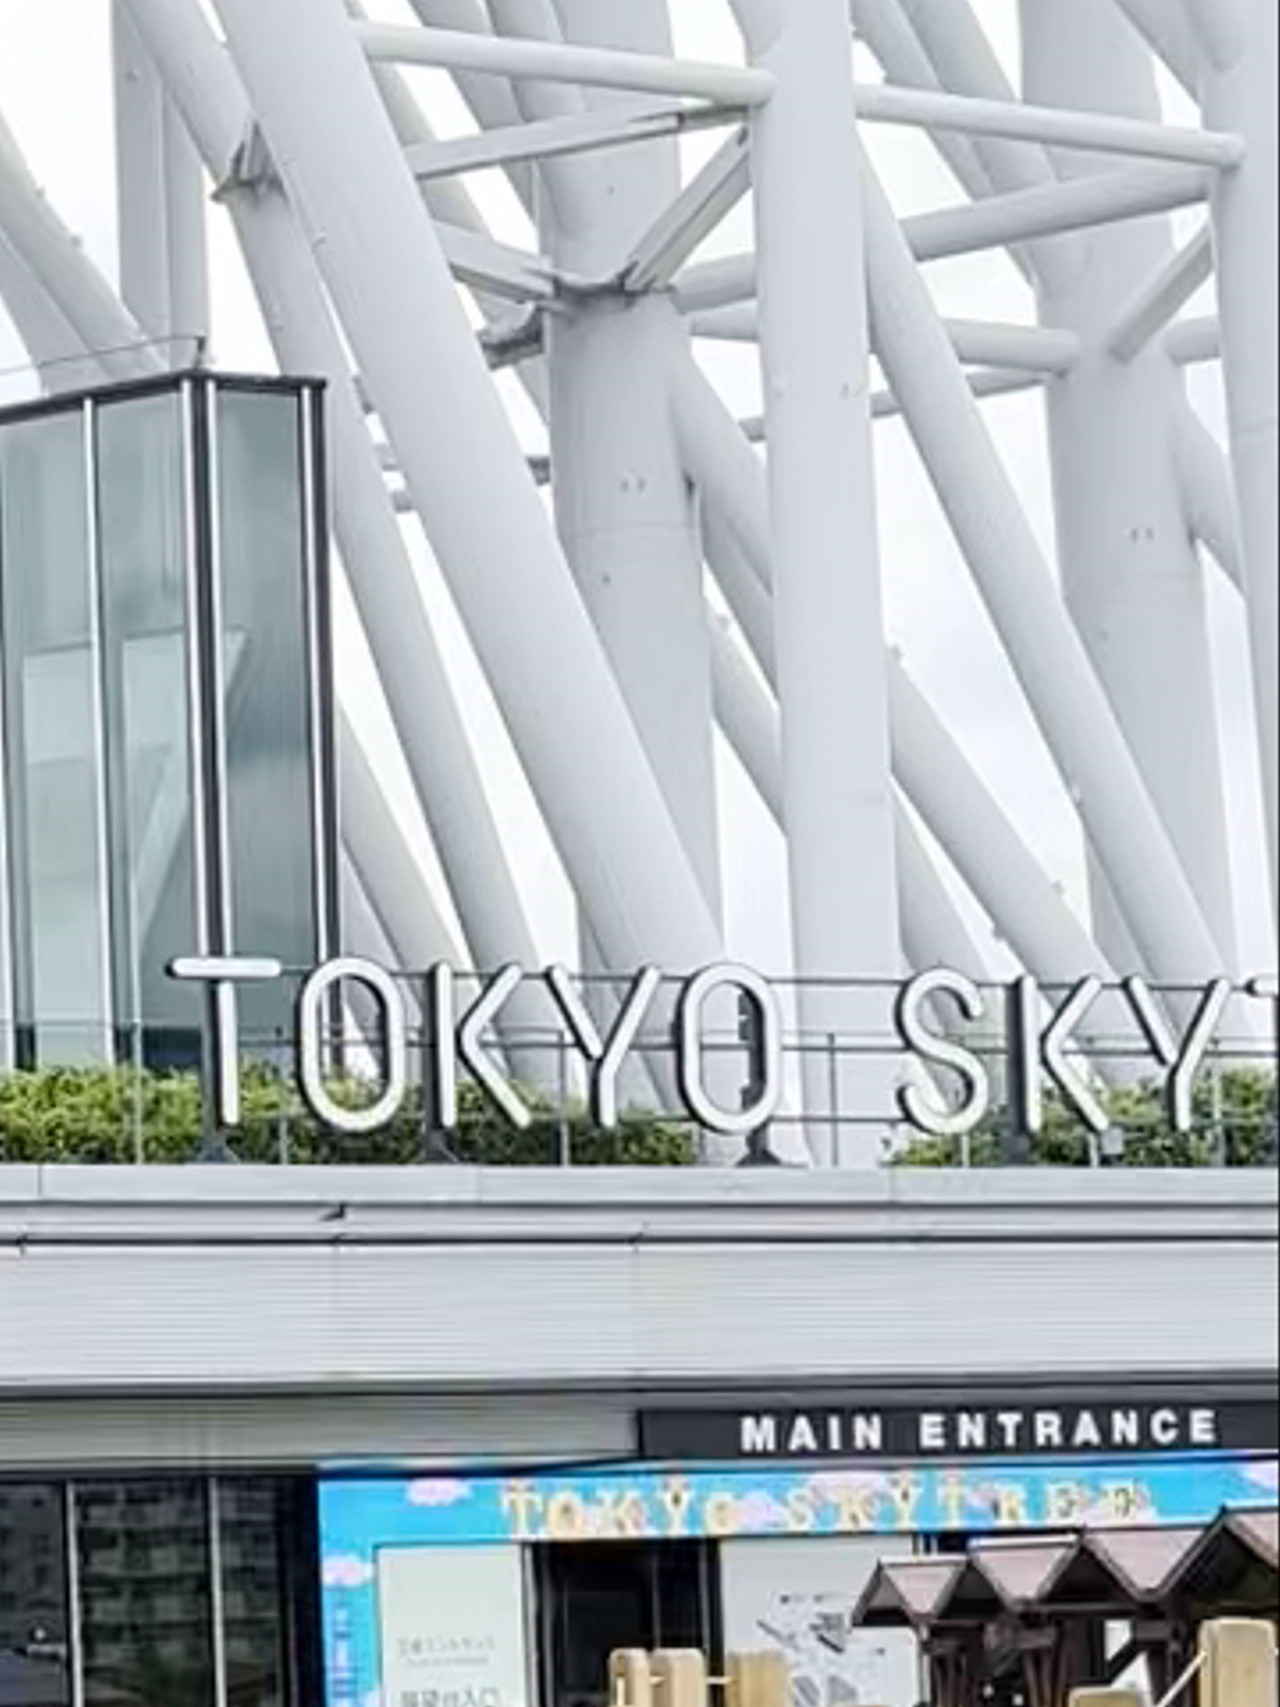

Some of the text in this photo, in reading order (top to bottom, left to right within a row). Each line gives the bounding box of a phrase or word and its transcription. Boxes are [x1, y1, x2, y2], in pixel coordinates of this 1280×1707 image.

[167, 957, 782, 1135] TOKYO
[740, 1408, 1218, 1453] MAIN ENTRANCE
[503, 1479, 738, 1537] TOKYO
